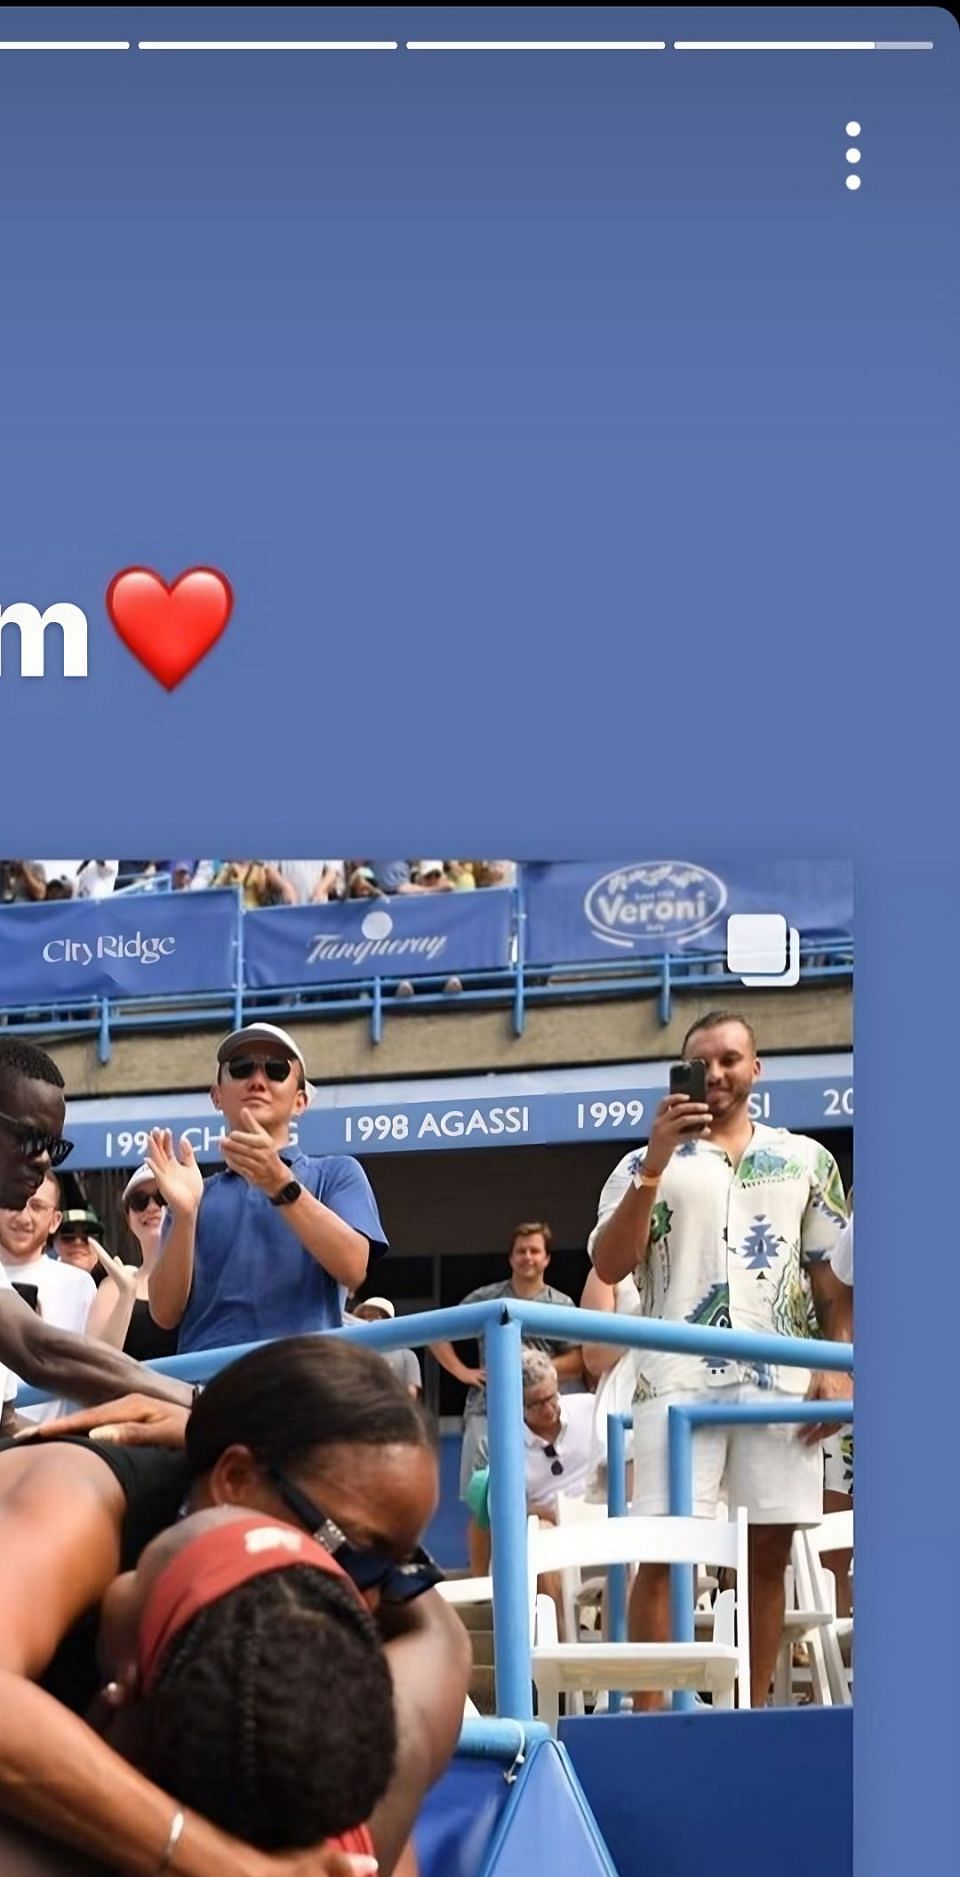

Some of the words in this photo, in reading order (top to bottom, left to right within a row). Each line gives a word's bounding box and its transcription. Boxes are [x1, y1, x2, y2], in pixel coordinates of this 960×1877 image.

[598, 889, 707, 926] Veroni
[42, 939, 93, 966] City
[97, 931, 177, 964] Ridge
[306, 934, 447, 965] Tanqueray
[345, 1114, 409, 1142] 1998
[417, 1106, 529, 1138] AGASSI
[577, 1100, 644, 1128] 1999
[106, 1131, 148, 1158] 199
[181, 1122, 299, 1151] CHG
